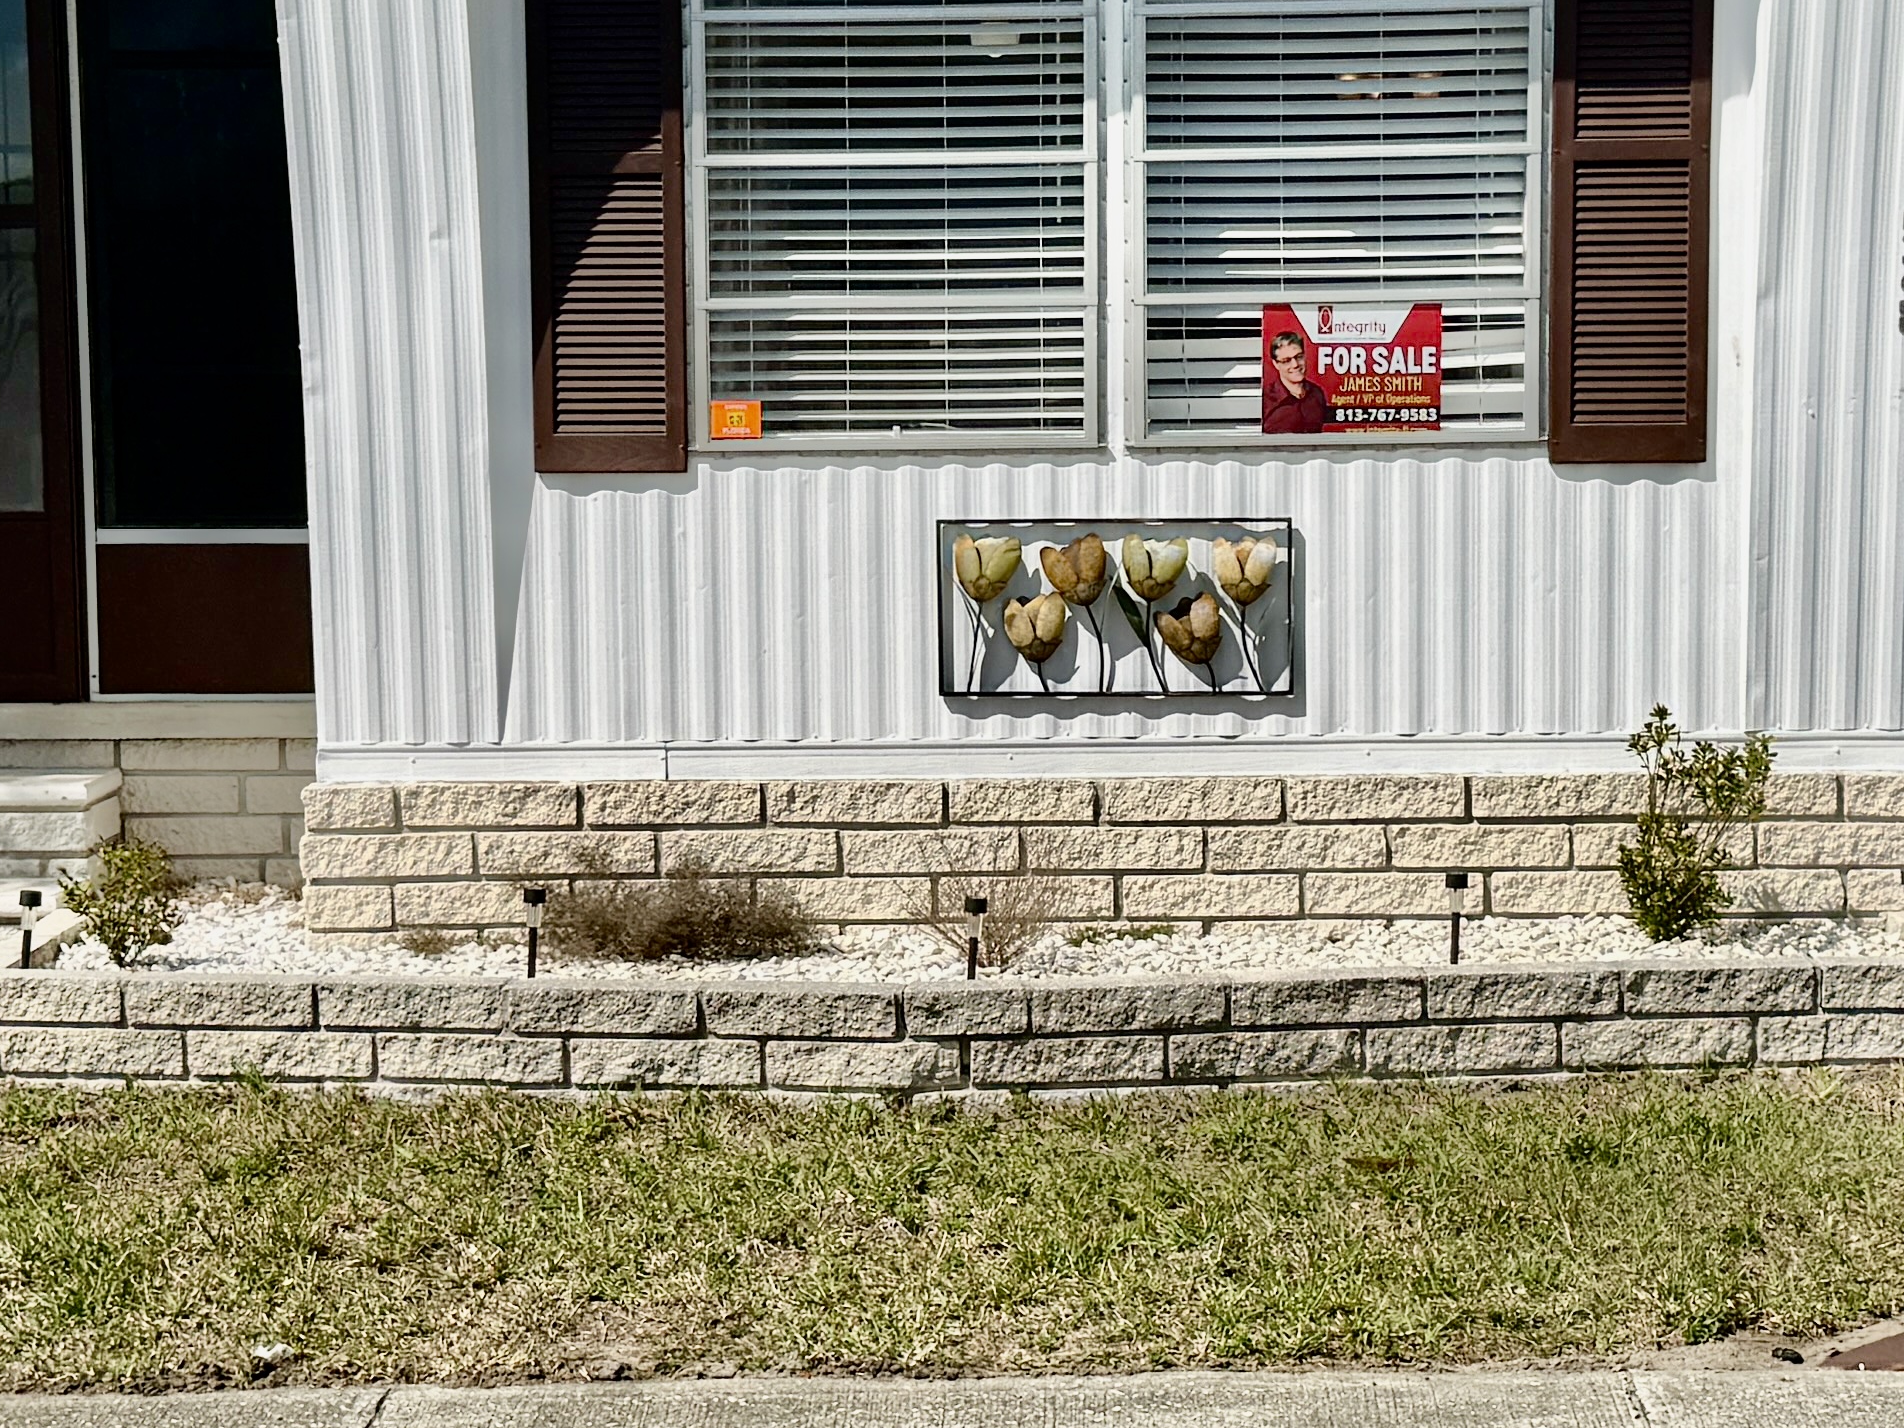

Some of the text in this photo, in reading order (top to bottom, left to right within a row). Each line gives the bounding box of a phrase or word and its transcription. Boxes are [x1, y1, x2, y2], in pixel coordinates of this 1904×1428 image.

[1317, 345, 1437, 375] FOR SALE
[1339, 375, 1422, 392] JAMES SMITH
[1335, 407, 1438, 422] 813-767-9583
